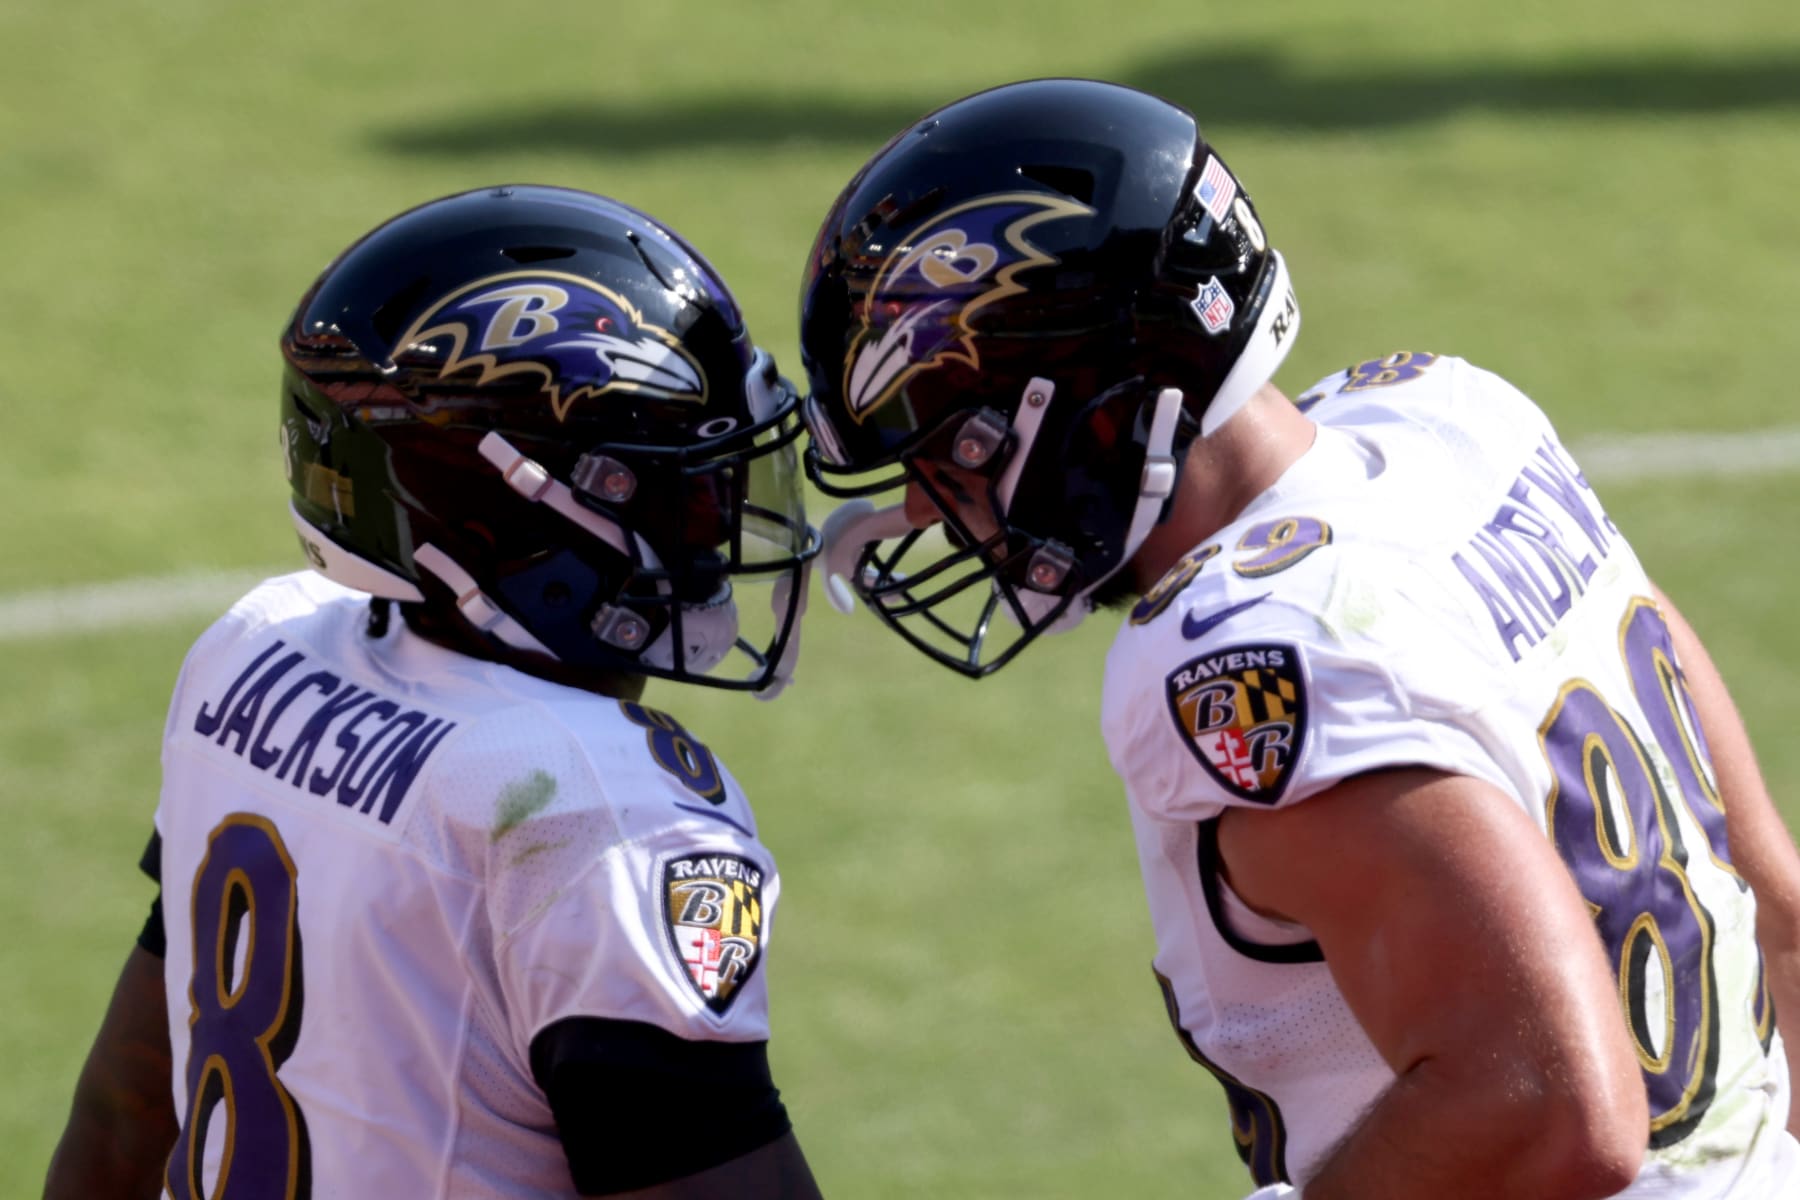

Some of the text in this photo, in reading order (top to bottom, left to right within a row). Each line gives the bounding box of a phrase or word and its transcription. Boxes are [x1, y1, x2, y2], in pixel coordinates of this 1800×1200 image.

[883, 228, 999, 291] B
[457, 284, 569, 351] B
[1205, 298, 1231, 328] NFL
[1172, 649, 1285, 692] RAVENS
[194, 639, 457, 826] JACKSON
[1180, 680, 1238, 733] B
[618, 700, 727, 806] 8
[1243, 721, 1294, 775] R
[671, 857, 761, 890] RAVENS
[672, 880, 727, 926] B
[718, 936, 755, 985] R
[165, 811, 313, 1200] 8
